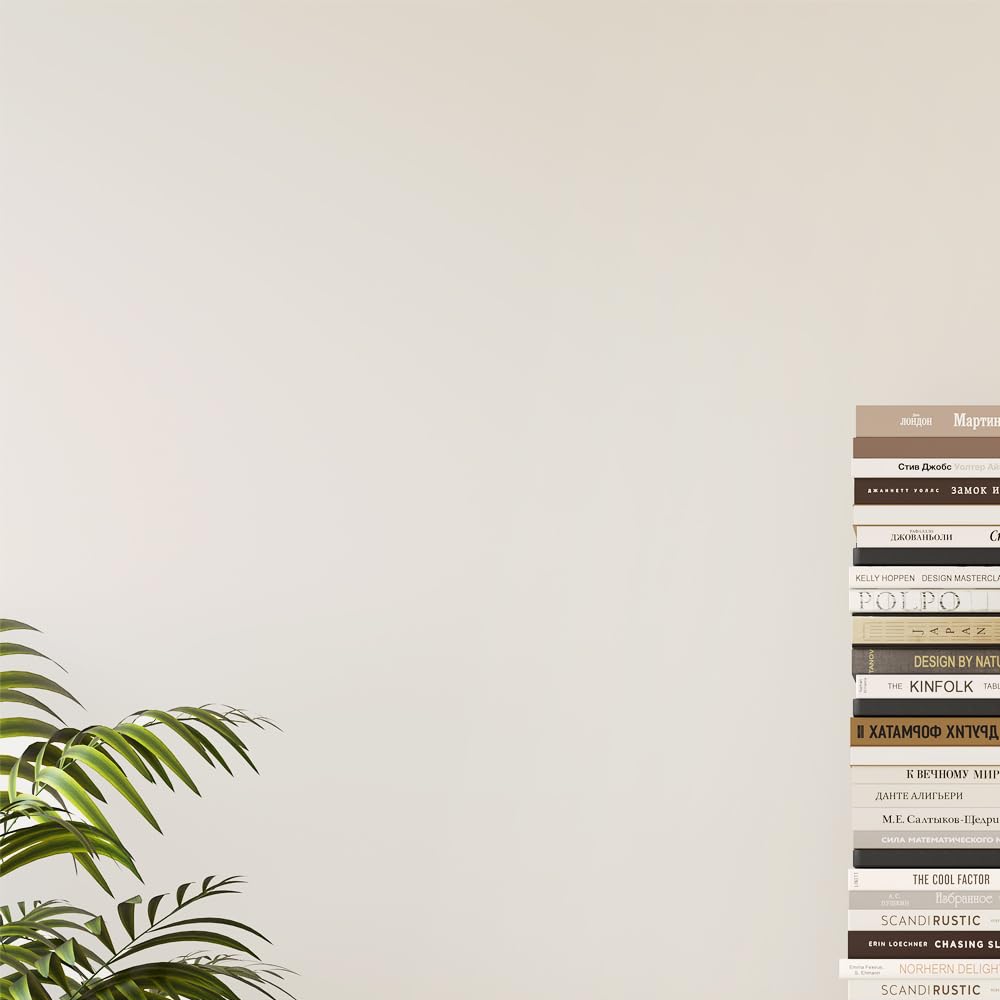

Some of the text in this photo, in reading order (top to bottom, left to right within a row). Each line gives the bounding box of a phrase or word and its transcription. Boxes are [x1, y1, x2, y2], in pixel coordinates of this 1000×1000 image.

[898, 463, 919, 471] Стив
[922, 463, 952, 472] Джобс
[954, 463, 985, 472] Уолтер
[890, 533, 953, 542] ДЖОВАНЬОЛИ
[859, 592, 961, 610] POLPO
[912, 627, 987, 635] JAPAN
[914, 655, 956, 668] DESIGN
[958, 655, 973, 668] BY
[910, 680, 974, 693] KINFOLK
[907, 770, 914, 779] К
[917, 769, 968, 779] ВЕЧНОМУ
[875, 792, 963, 801] ДАНТЕ АЛИГЬЕРИ
[882, 815, 905, 824] М.Е.
[881, 836, 906, 844] СИЛА
[908, 836, 994, 844] МАТЕМАТИЧЕСКОГО
[913, 874, 990, 885] THE COOL FACTOR
[936, 892, 993, 908] Избранное
[934, 940, 984, 949] CHASING
[899, 964, 955, 974] NORHERN
